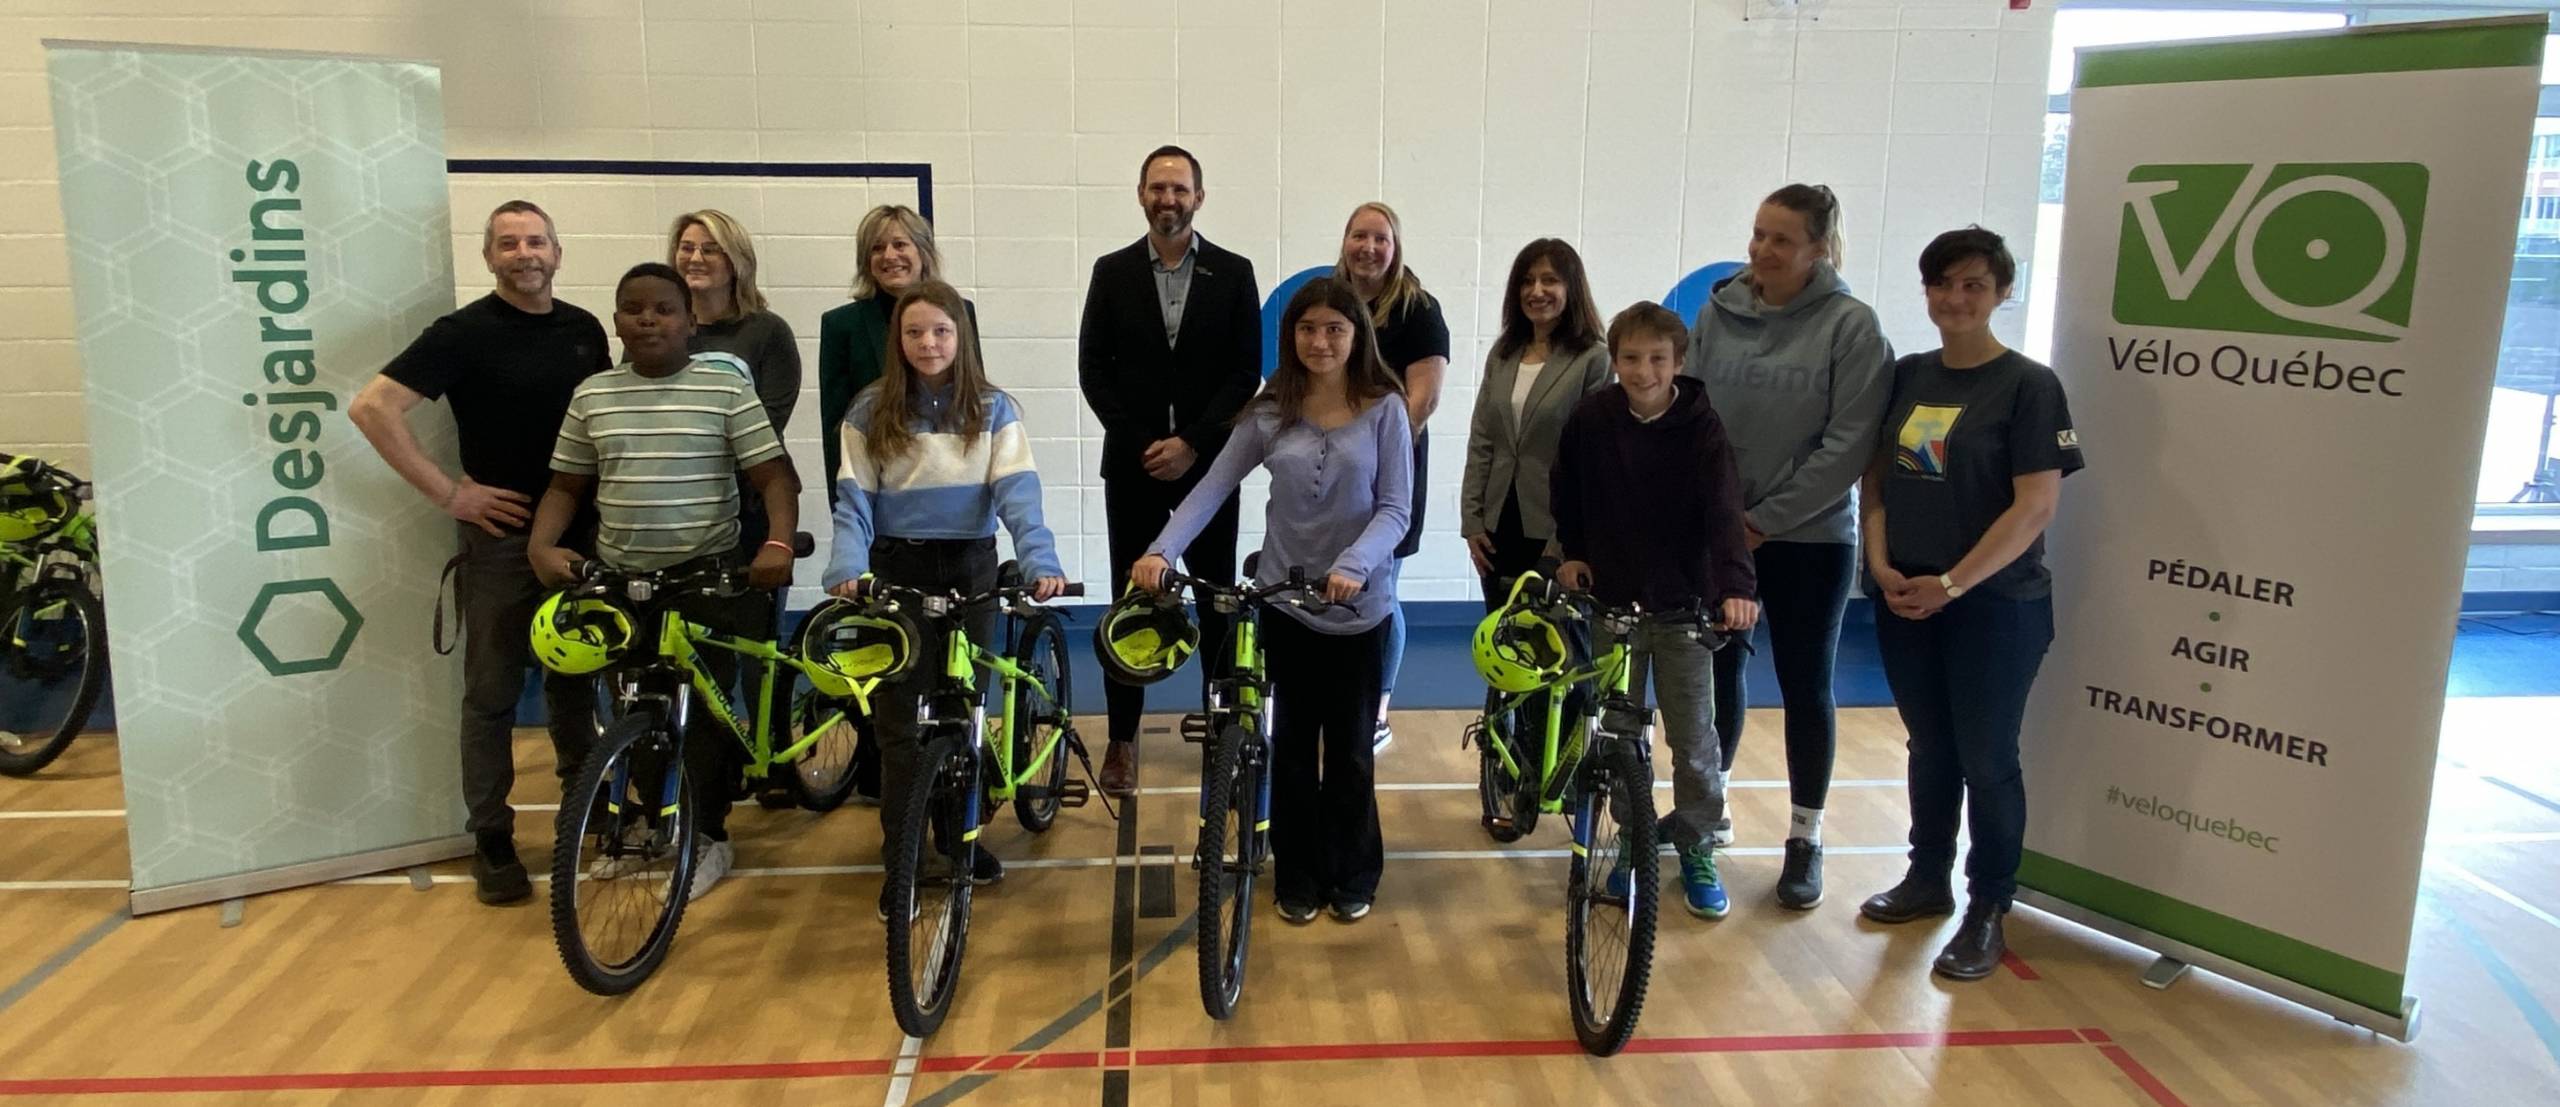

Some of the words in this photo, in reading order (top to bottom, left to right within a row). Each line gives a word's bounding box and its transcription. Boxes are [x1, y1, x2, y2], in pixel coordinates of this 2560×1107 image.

[2117, 163, 2413, 342] VQ
[230, 159, 338, 552] Desjardins
[2108, 336, 2201, 377] Vélo
[2211, 337, 2406, 397] Québec
[2147, 558, 2295, 608] PÉDALER
[2170, 636, 2250, 673] AGIR
[2084, 684, 2328, 767] TRANSFORMER
[2105, 784, 2280, 855] #veloquebec
